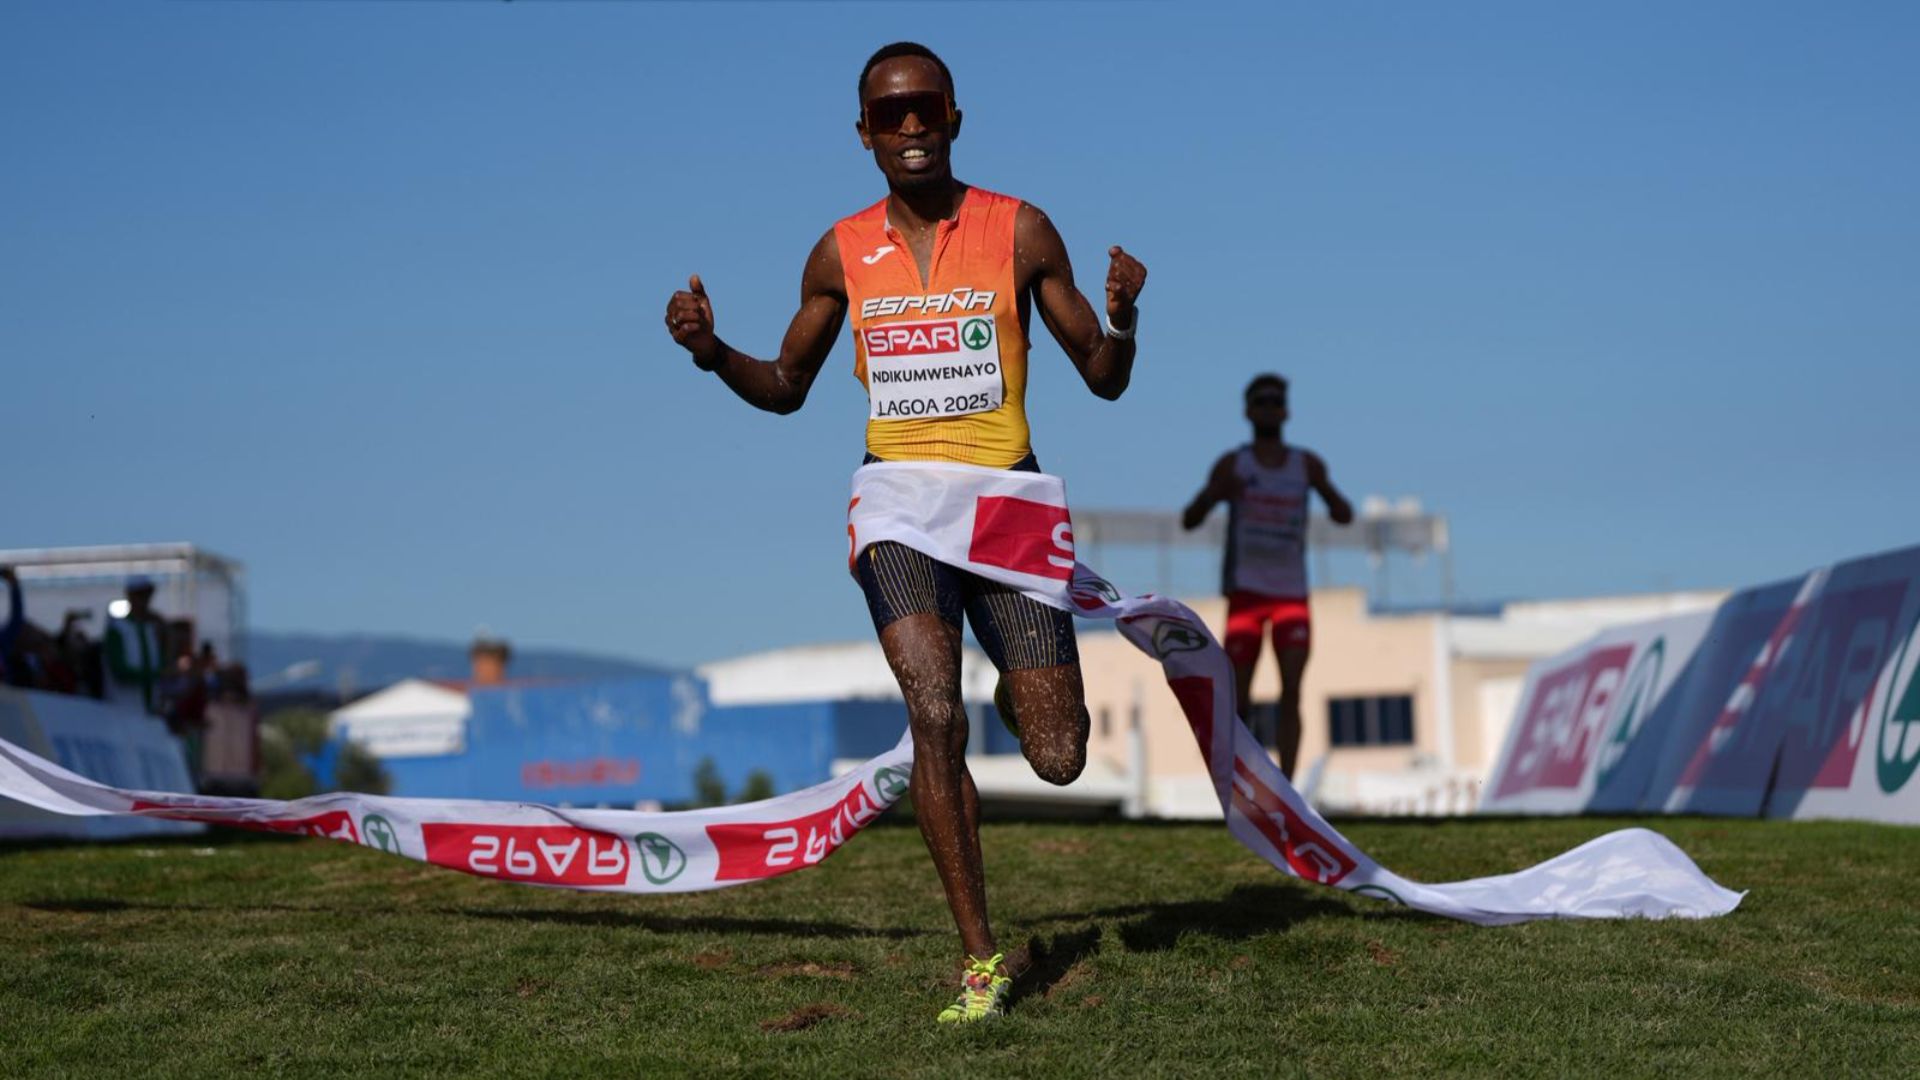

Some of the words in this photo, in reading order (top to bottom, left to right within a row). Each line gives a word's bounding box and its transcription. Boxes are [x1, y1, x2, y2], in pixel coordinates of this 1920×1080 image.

[861, 287, 997, 320] ESPAÑA
[867, 326, 957, 352] SPAR
[872, 362, 997, 384] NDIKUMWENAYO
[877, 398, 939, 417] LAGOA
[944, 393, 989, 413] 2025
